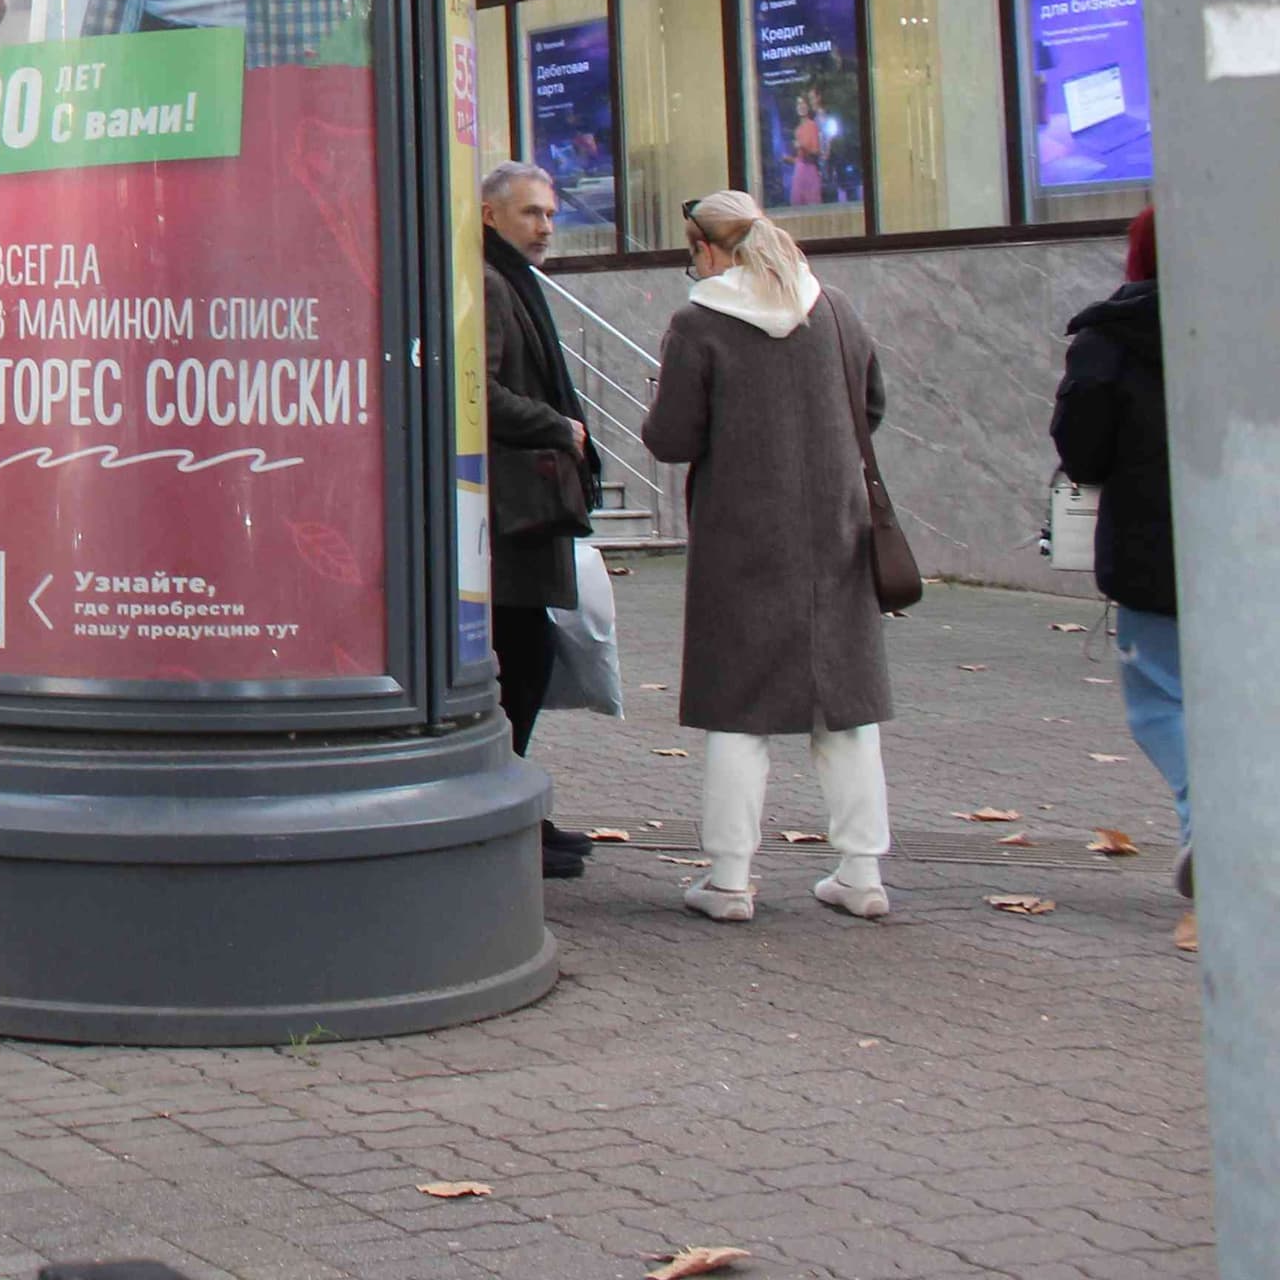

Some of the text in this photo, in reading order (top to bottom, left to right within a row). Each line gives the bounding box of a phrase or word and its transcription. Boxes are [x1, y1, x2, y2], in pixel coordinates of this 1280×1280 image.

[1041, 2, 1070, 20] для
[760, 24, 805, 44] Кредит
[762, 40, 832, 60] наличными
[55, 62, 107, 94] ЛЕТ
[84, 91, 197, 141] вами!
[19, 297, 194, 342] МАМИНОМ
[208, 297, 320, 340] СПИСКЕ
[146, 357, 369, 427] СОСИСКИ!
[74, 571, 216, 597] Узнайте,
[74, 601, 246, 619] где приобрести
[74, 624, 300, 640] нашу продукцию тут
